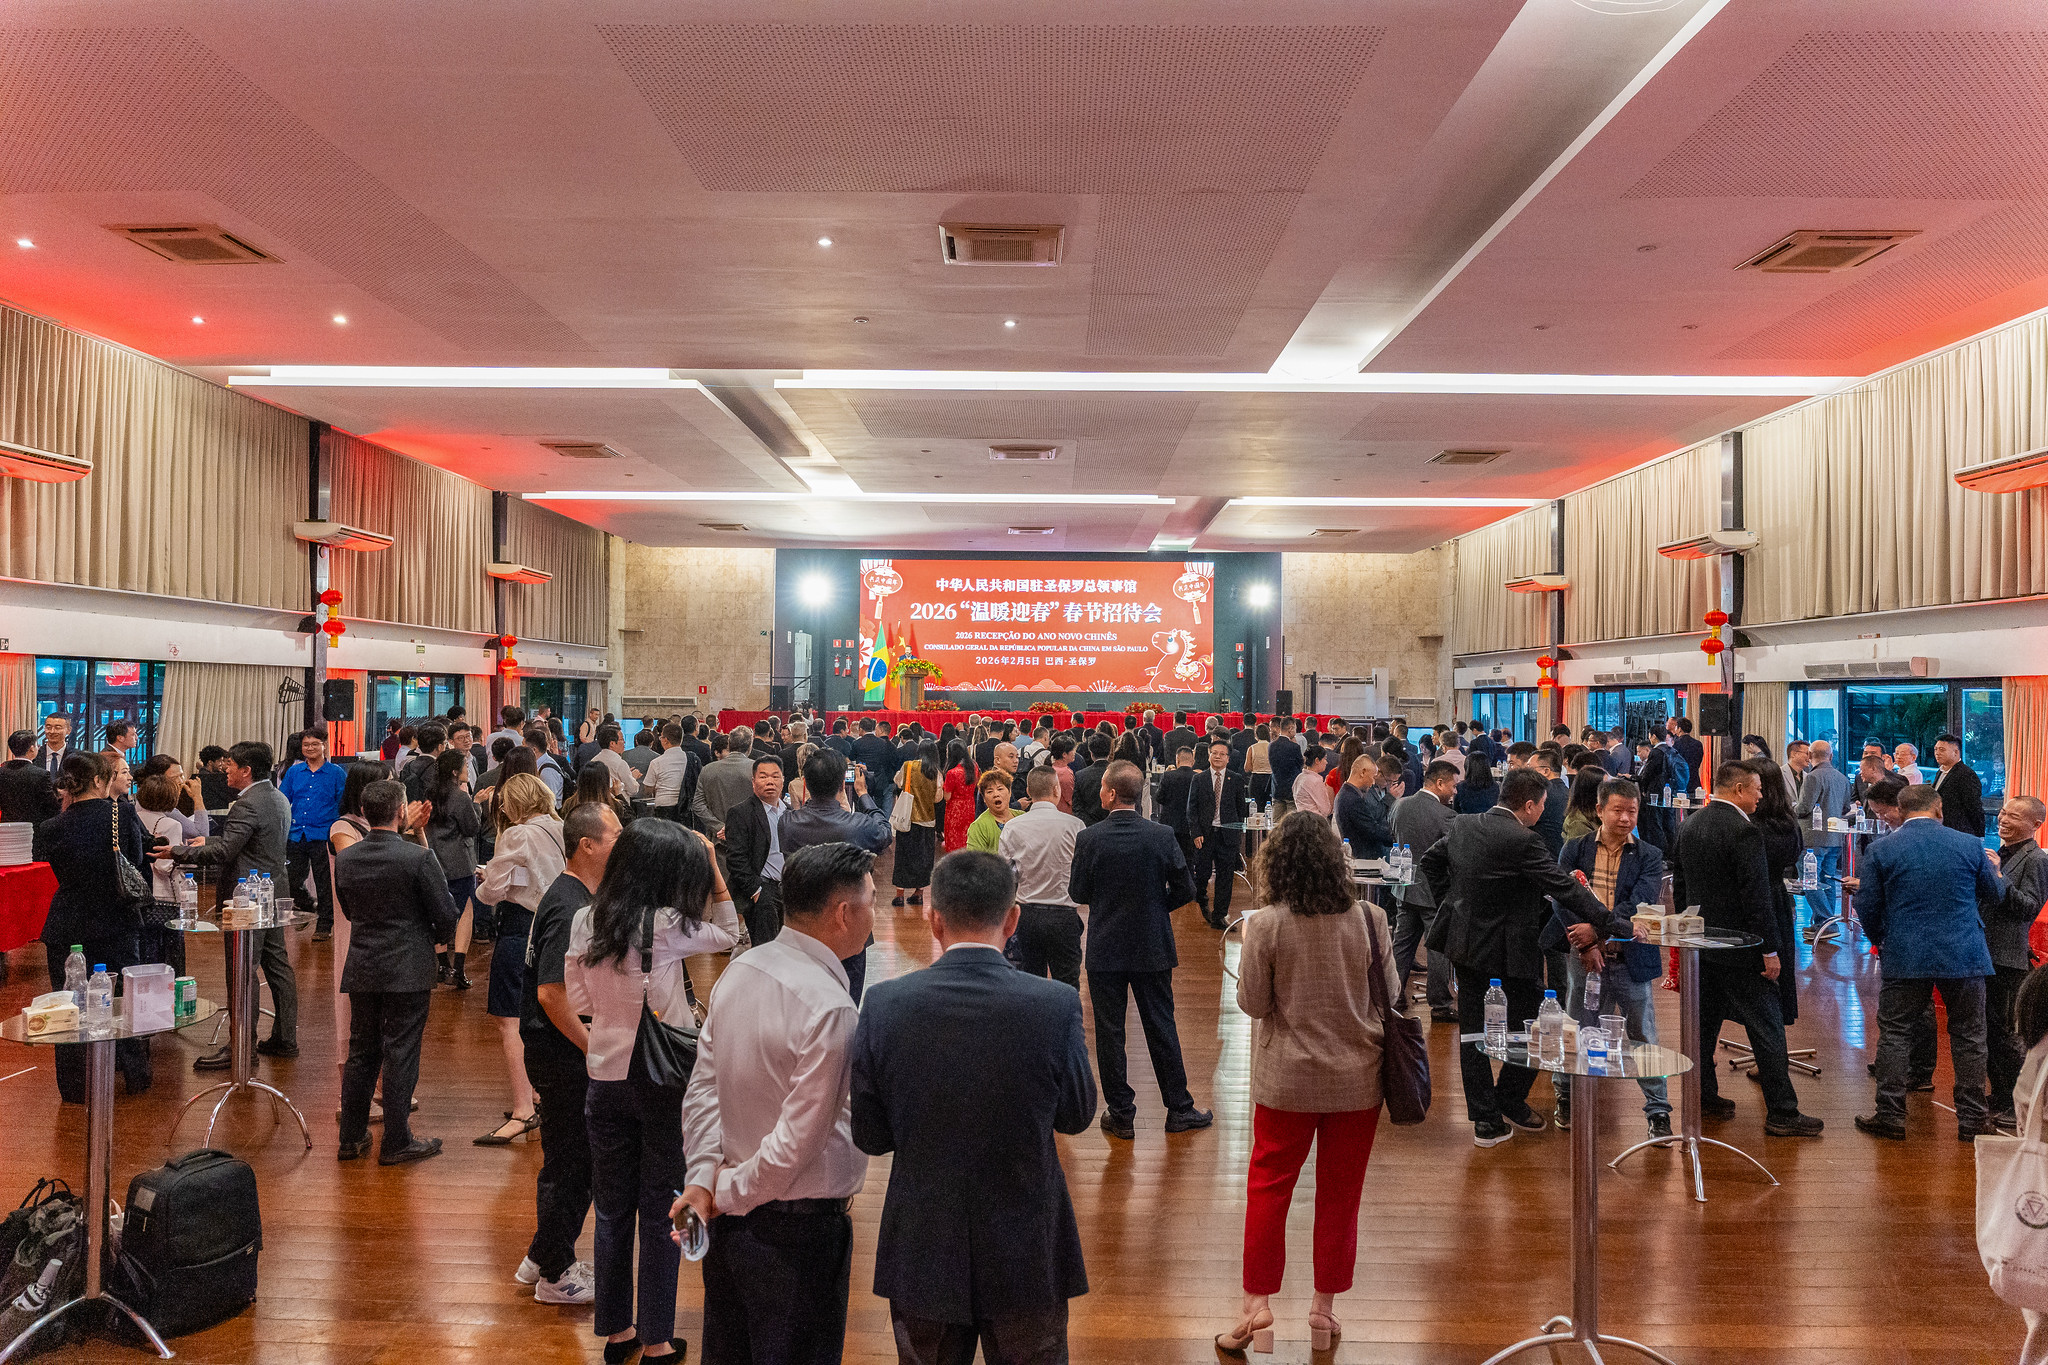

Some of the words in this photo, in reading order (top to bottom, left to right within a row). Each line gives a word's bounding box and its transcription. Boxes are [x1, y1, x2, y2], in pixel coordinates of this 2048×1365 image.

[935, 578, 1137, 593] 中华人民共和国驻圣保罗总领事馆
[955, 631, 973, 640] 2026
[974, 630, 1022, 641] RECEPÇÃO
[1022, 632, 1036, 640] DO
[1037, 632, 1057, 640] ANO
[1058, 632, 1082, 640] NOVO
[1084, 631, 1117, 640] CHINÊS
[923, 643, 965, 651] CONSULADO
[999, 643, 1036, 651] REPÚBLICA
[1112, 644, 1126, 652] SÃO
[975, 656, 1040, 666] 2026年2月5日
